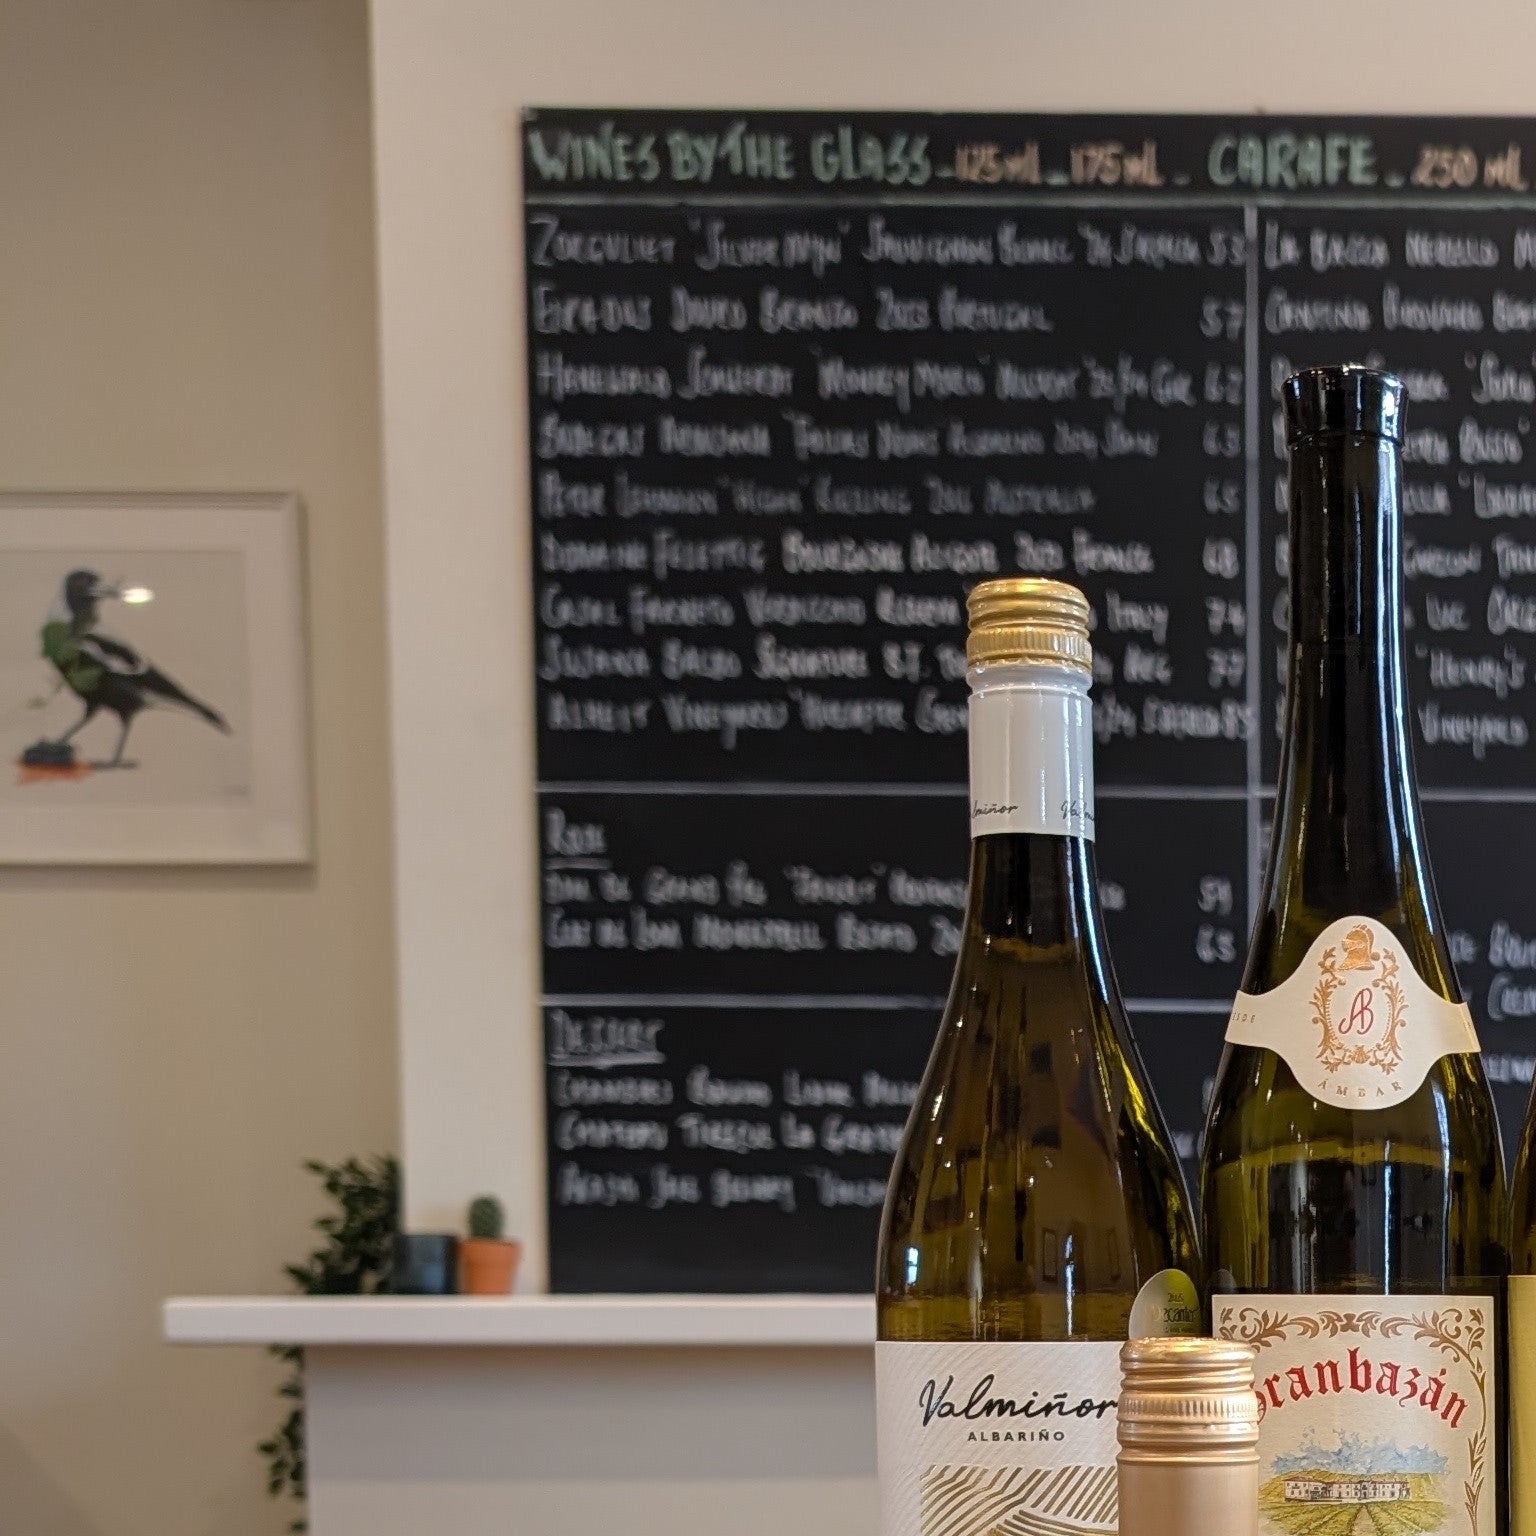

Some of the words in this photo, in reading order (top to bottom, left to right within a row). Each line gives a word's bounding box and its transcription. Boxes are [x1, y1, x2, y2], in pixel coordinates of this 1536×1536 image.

[528, 122, 659, 180] WINES
[810, 125, 932, 184] GLASS
[919, 1373, 1119, 1428] Valmiñor
[967, 1429, 1065, 1442] ALBARIÑO
